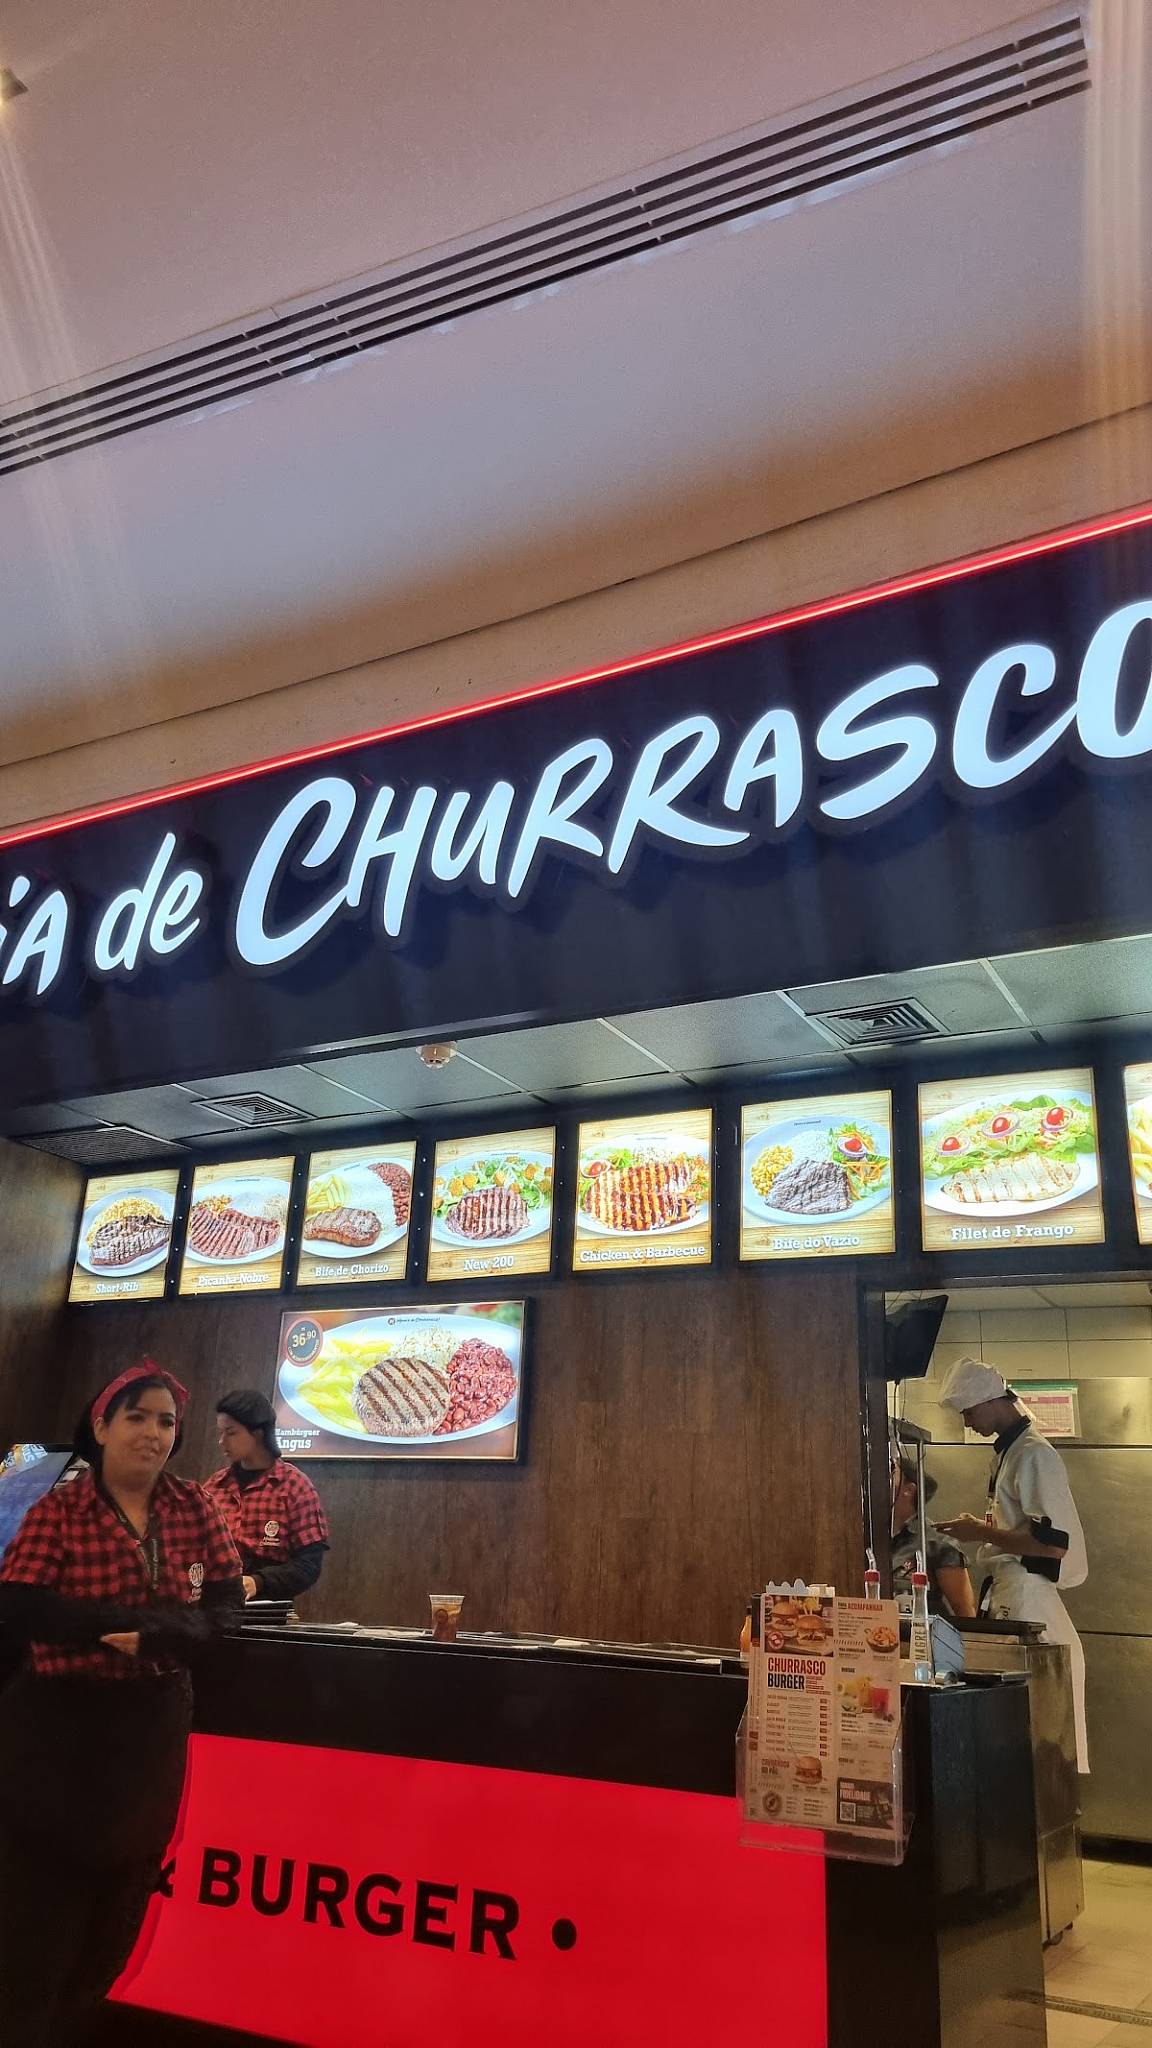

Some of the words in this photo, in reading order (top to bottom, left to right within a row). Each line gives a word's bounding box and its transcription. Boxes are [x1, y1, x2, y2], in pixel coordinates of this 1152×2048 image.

[95, 833, 204, 970] de
[236, 599, 1152, 965] CHURRASCO
[951, 1226, 988, 1241] Filet
[992, 1226, 1011, 1238] de
[1015, 1224, 1074, 1240] Frango
[773, 1238, 801, 1250] Bife
[804, 1236, 821, 1248] do
[820, 1234, 861, 1248] Vazio
[580, 1249, 631, 1262] Chicken
[633, 1247, 645, 1259] &
[646, 1246, 706, 1260] Barbecue
[315, 1265, 335, 1276] Bife
[336, 1265, 349, 1275] de
[350, 1263, 390, 1275] Chorizo
[464, 1258, 490, 1271] New
[492, 1255, 515, 1269] 200
[198, 1274, 240, 1287] Picanha
[240, 1272, 271, 1285] Nobre
[275, 1436, 312, 1452] Angus
[767, 1657, 826, 1676] CHURRASCO
[767, 1673, 805, 1690] BURGER
[198, 1847, 519, 1960] BURGER
